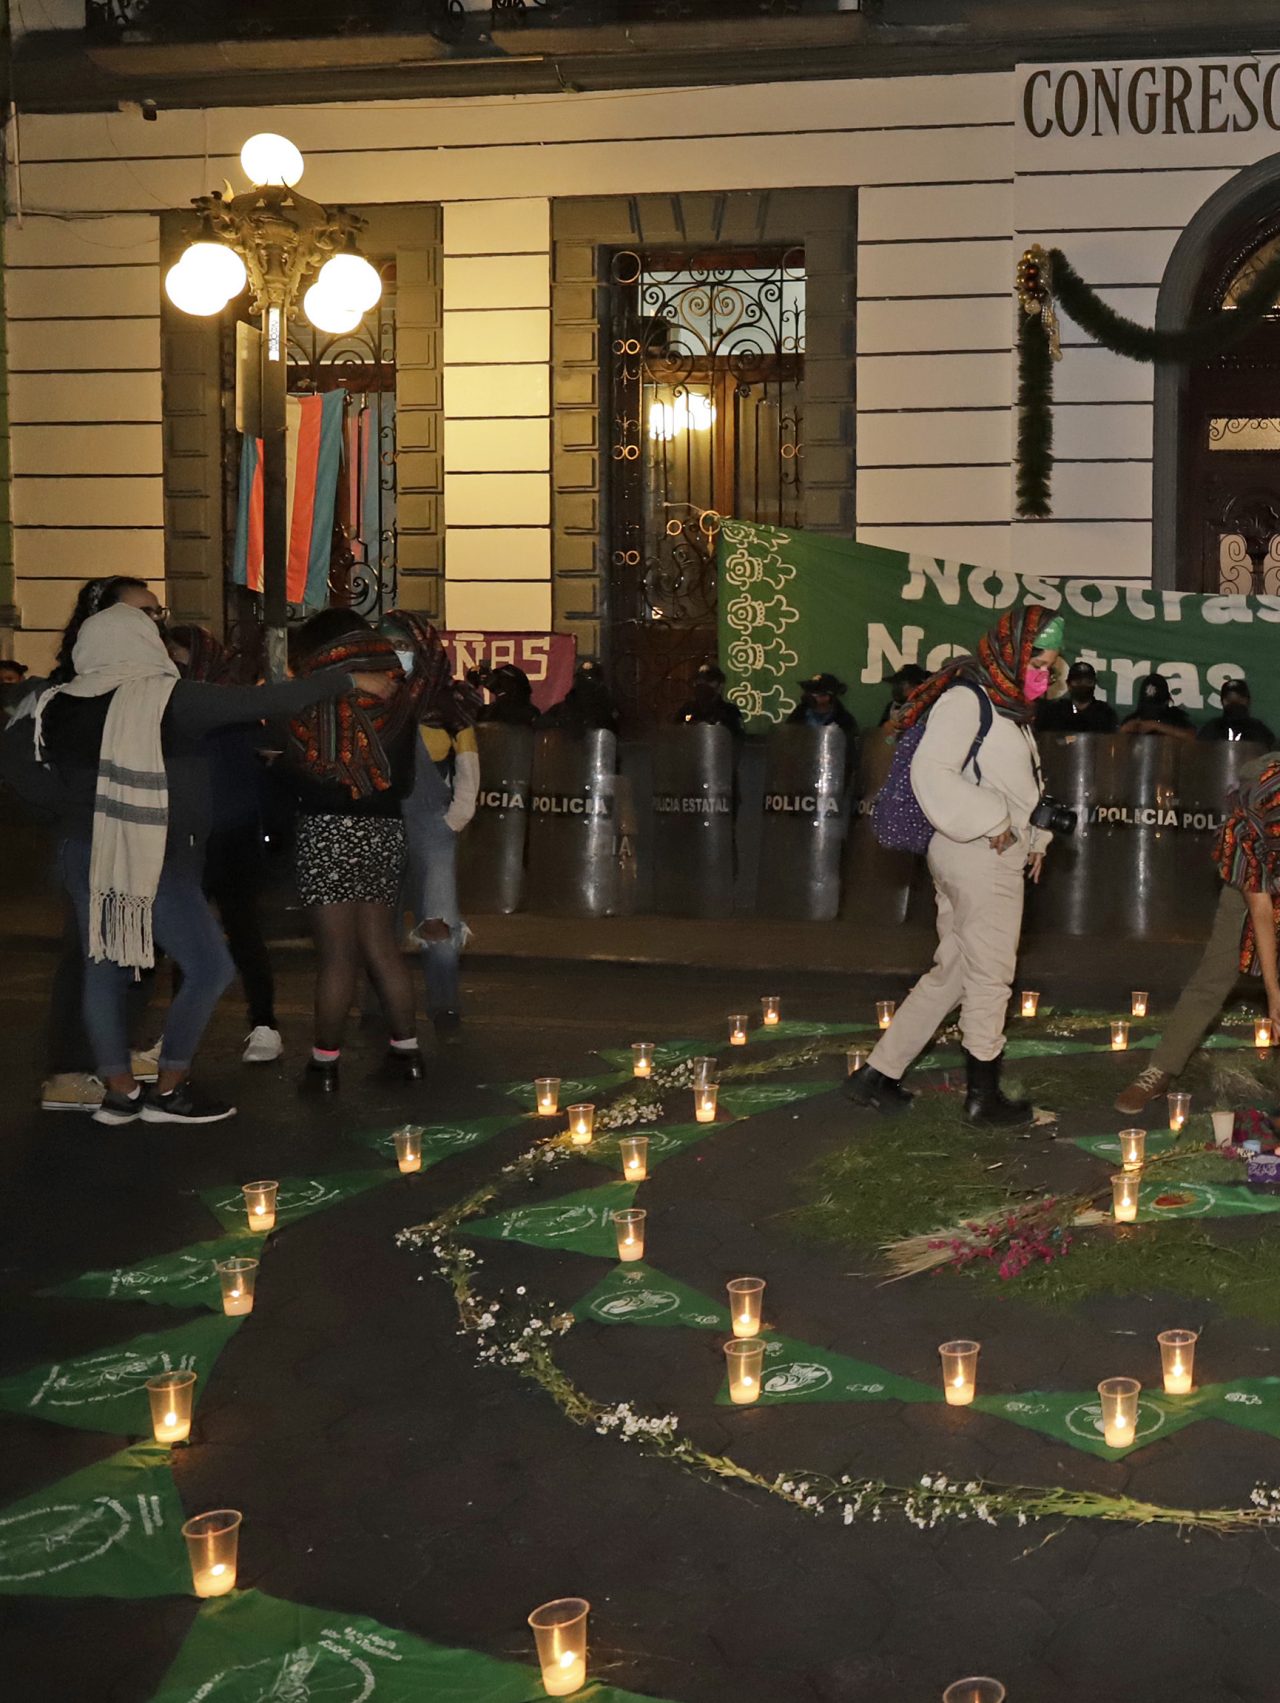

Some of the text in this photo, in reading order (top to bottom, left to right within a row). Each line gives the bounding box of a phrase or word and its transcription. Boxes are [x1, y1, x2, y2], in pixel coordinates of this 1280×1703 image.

[441, 632, 550, 681] ÑAS
[533, 796, 608, 815] POLICIA
[765, 795, 840, 813] POLICIA
